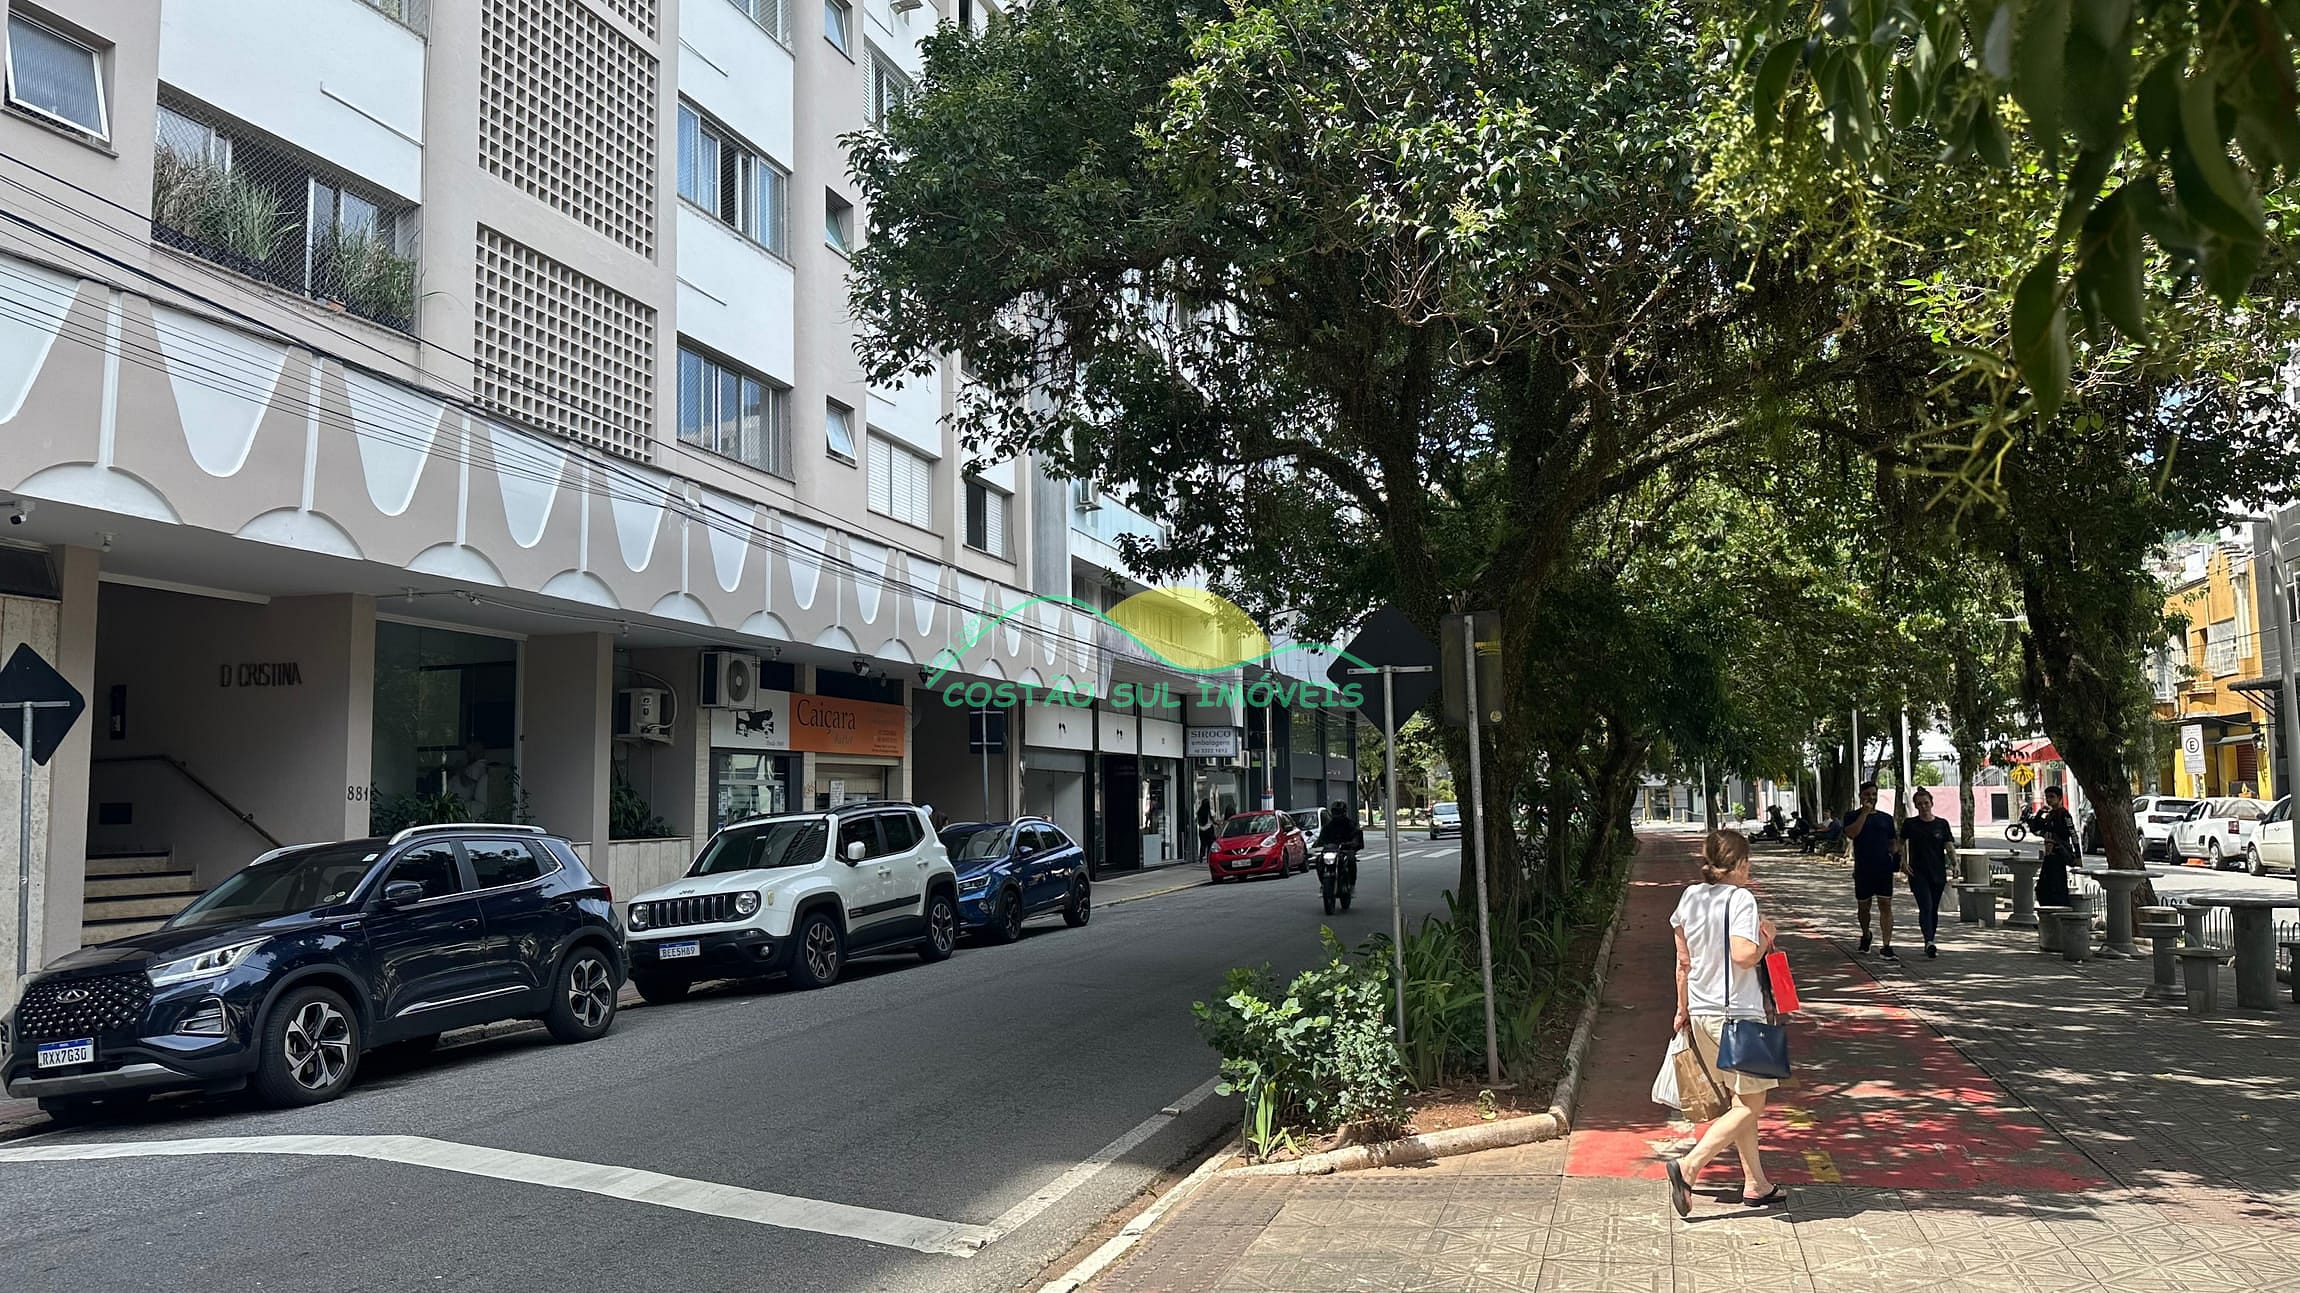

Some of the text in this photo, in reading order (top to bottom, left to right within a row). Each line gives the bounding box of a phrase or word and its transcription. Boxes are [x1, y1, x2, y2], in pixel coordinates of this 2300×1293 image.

[238, 662, 302, 687] CRISTINA
[797, 699, 856, 734] Caiçara
[1191, 730, 1231, 738] SIROCO
[2190, 741, 2195, 750] E
[347, 786, 368, 801] 881
